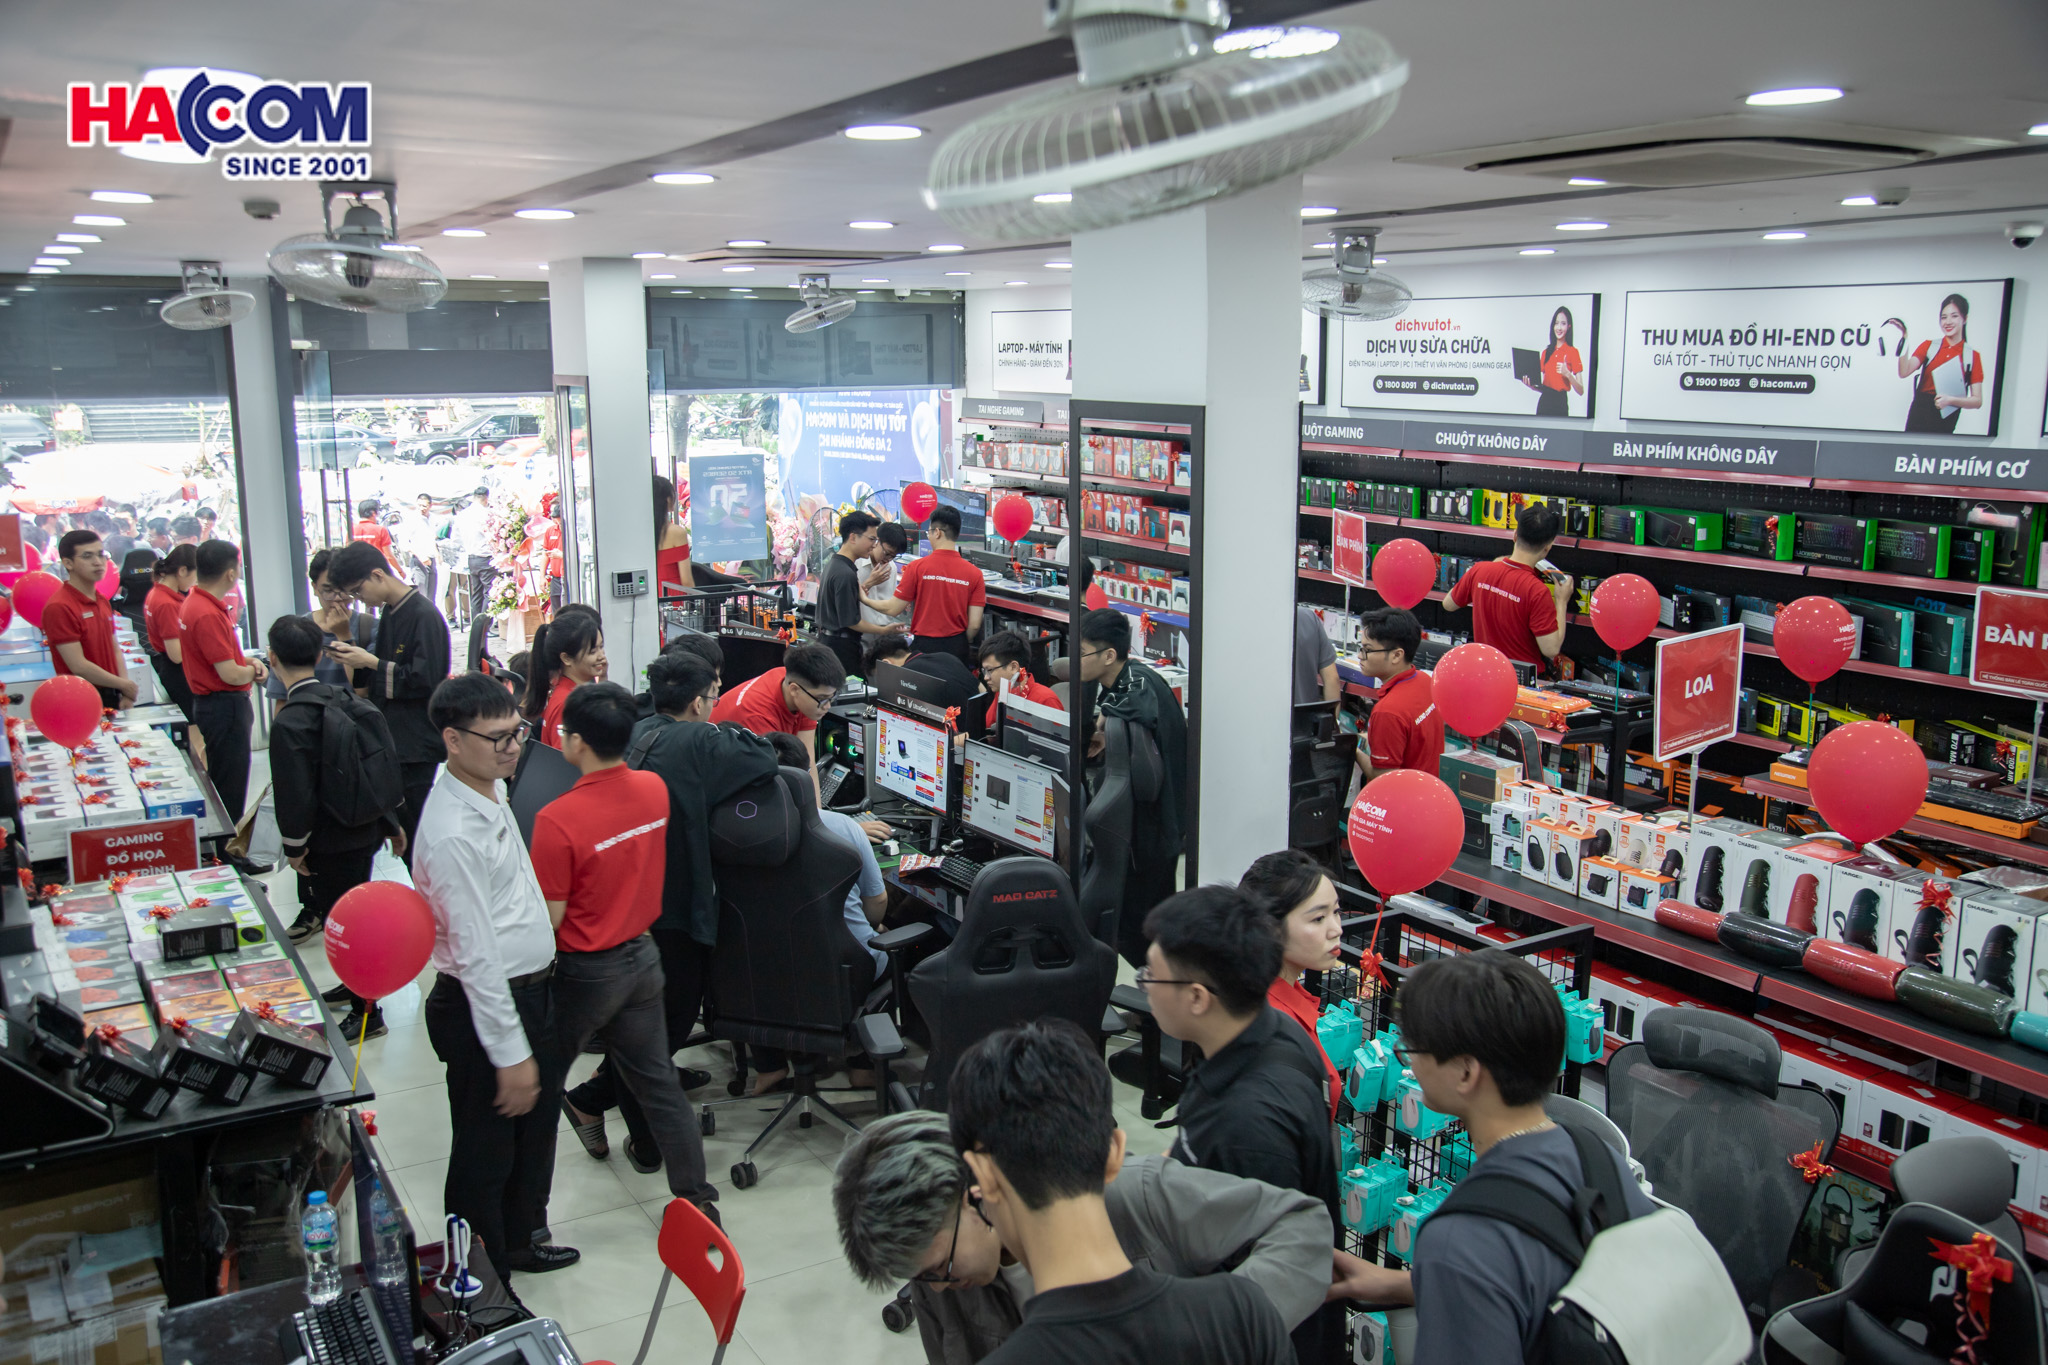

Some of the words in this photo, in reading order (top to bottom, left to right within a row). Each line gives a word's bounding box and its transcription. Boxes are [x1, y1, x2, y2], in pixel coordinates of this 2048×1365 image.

[1642, 329, 1678, 346] THU
[1682, 329, 1724, 346] MUA
[1729, 322, 1757, 346] ĐỒ
[1762, 328, 1835, 346] HI-END
[1841, 324, 1871, 346] CŨ
[998, 343, 1024, 353] LAPTOP
[1029, 341, 1044, 353] MÁY
[1045, 341, 1063, 353] TÍNH
[1367, 339, 1396, 355] DỊCH
[1399, 340, 1417, 357] VỤ
[1420, 335, 1448, 354] SỬA
[1451, 336, 1491, 354] CHỮA
[1380, 360, 1400, 368] LAPTOP
[1403, 361, 1410, 369] PC
[1414, 359, 1429, 369] THIẾT
[1449, 360, 1469, 369] PHÒNG
[1472, 362, 1494, 370] GAMING
[1495, 362, 1512, 370] GEAR
[1653, 353, 1673, 366] GIÁ
[1676, 350, 1698, 366] TỐT
[1709, 351, 1735, 367] THỦ
[1739, 355, 1764, 370] TỤC
[1766, 355, 1816, 368] NHANH
[1820, 355, 1851, 371] GỌN
[1385, 379, 1400, 389] 1800
[1401, 380, 1417, 389] 8091
[1431, 382, 1475, 391] dichvutot.vn
[1695, 377, 1717, 387] 1900
[1718, 377, 1741, 388] 1903
[1760, 379, 1808, 389] hacom.vn
[978, 405, 987, 413] TAI
[987, 405, 1002, 415] NGHE
[1002, 406, 1024, 416] GAMING
[1057, 409, 1068, 419] TAI
[838, 409, 850, 428] VÀ
[851, 413, 872, 433] DỊCH
[874, 415, 887, 434] VỤ
[888, 410, 907, 432] TỐT
[1324, 426, 1364, 439] GAMING
[819, 434, 830, 447] CHI
[831, 433, 855, 448] NHÁNH
[876, 437, 886, 450] ĐA
[887, 438, 892, 451] 2
[1435, 432, 1475, 449] CHUỘT
[1476, 432, 1519, 449] KHÔNG
[1521, 435, 1548, 451] DÂY
[1613, 442, 1643, 458] BÀN
[1645, 443, 1684, 460] PHÍM
[1686, 445, 1742, 463] KHÔNG
[1745, 446, 1778, 465] DÂY
[1894, 457, 1936, 474] BÀN
[1938, 458, 1992, 477] PHÍM
[1997, 460, 2030, 479] CƠ
[1985, 624, 2034, 648] BÀN
[1685, 674, 1713, 699] LOA
[105, 832, 164, 848] GAMING
[133, 849, 166, 862] HỌA
[993, 892, 1022, 903] MAD
[1025, 889, 1058, 900] CATZ
